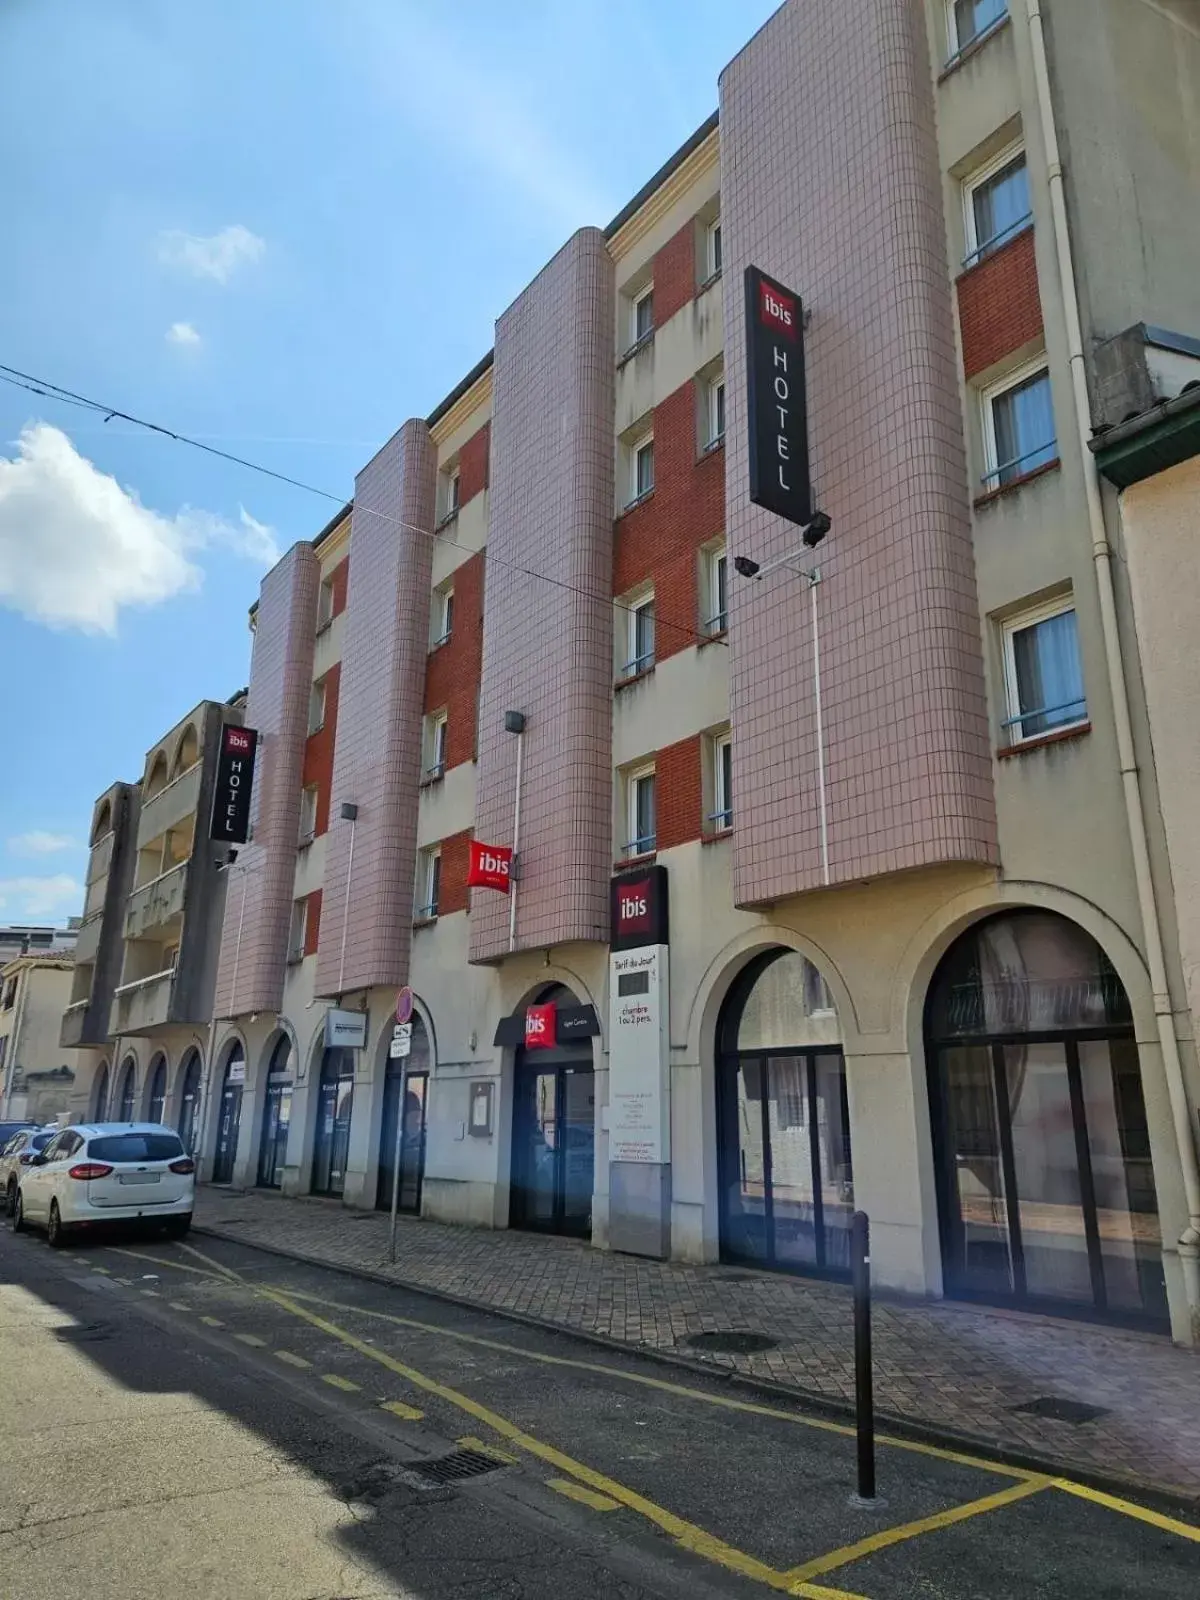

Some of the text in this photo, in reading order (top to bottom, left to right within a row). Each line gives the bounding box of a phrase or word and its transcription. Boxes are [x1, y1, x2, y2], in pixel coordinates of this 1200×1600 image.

[764, 294, 792, 326] ibis
[773, 345, 791, 490] HOTEL
[229, 736, 248, 748] ibis
[226, 761, 241, 831] HOTEL
[479, 852, 509, 875] ibis
[622, 896, 647, 920] ibis
[622, 1002, 648, 1015] chambre
